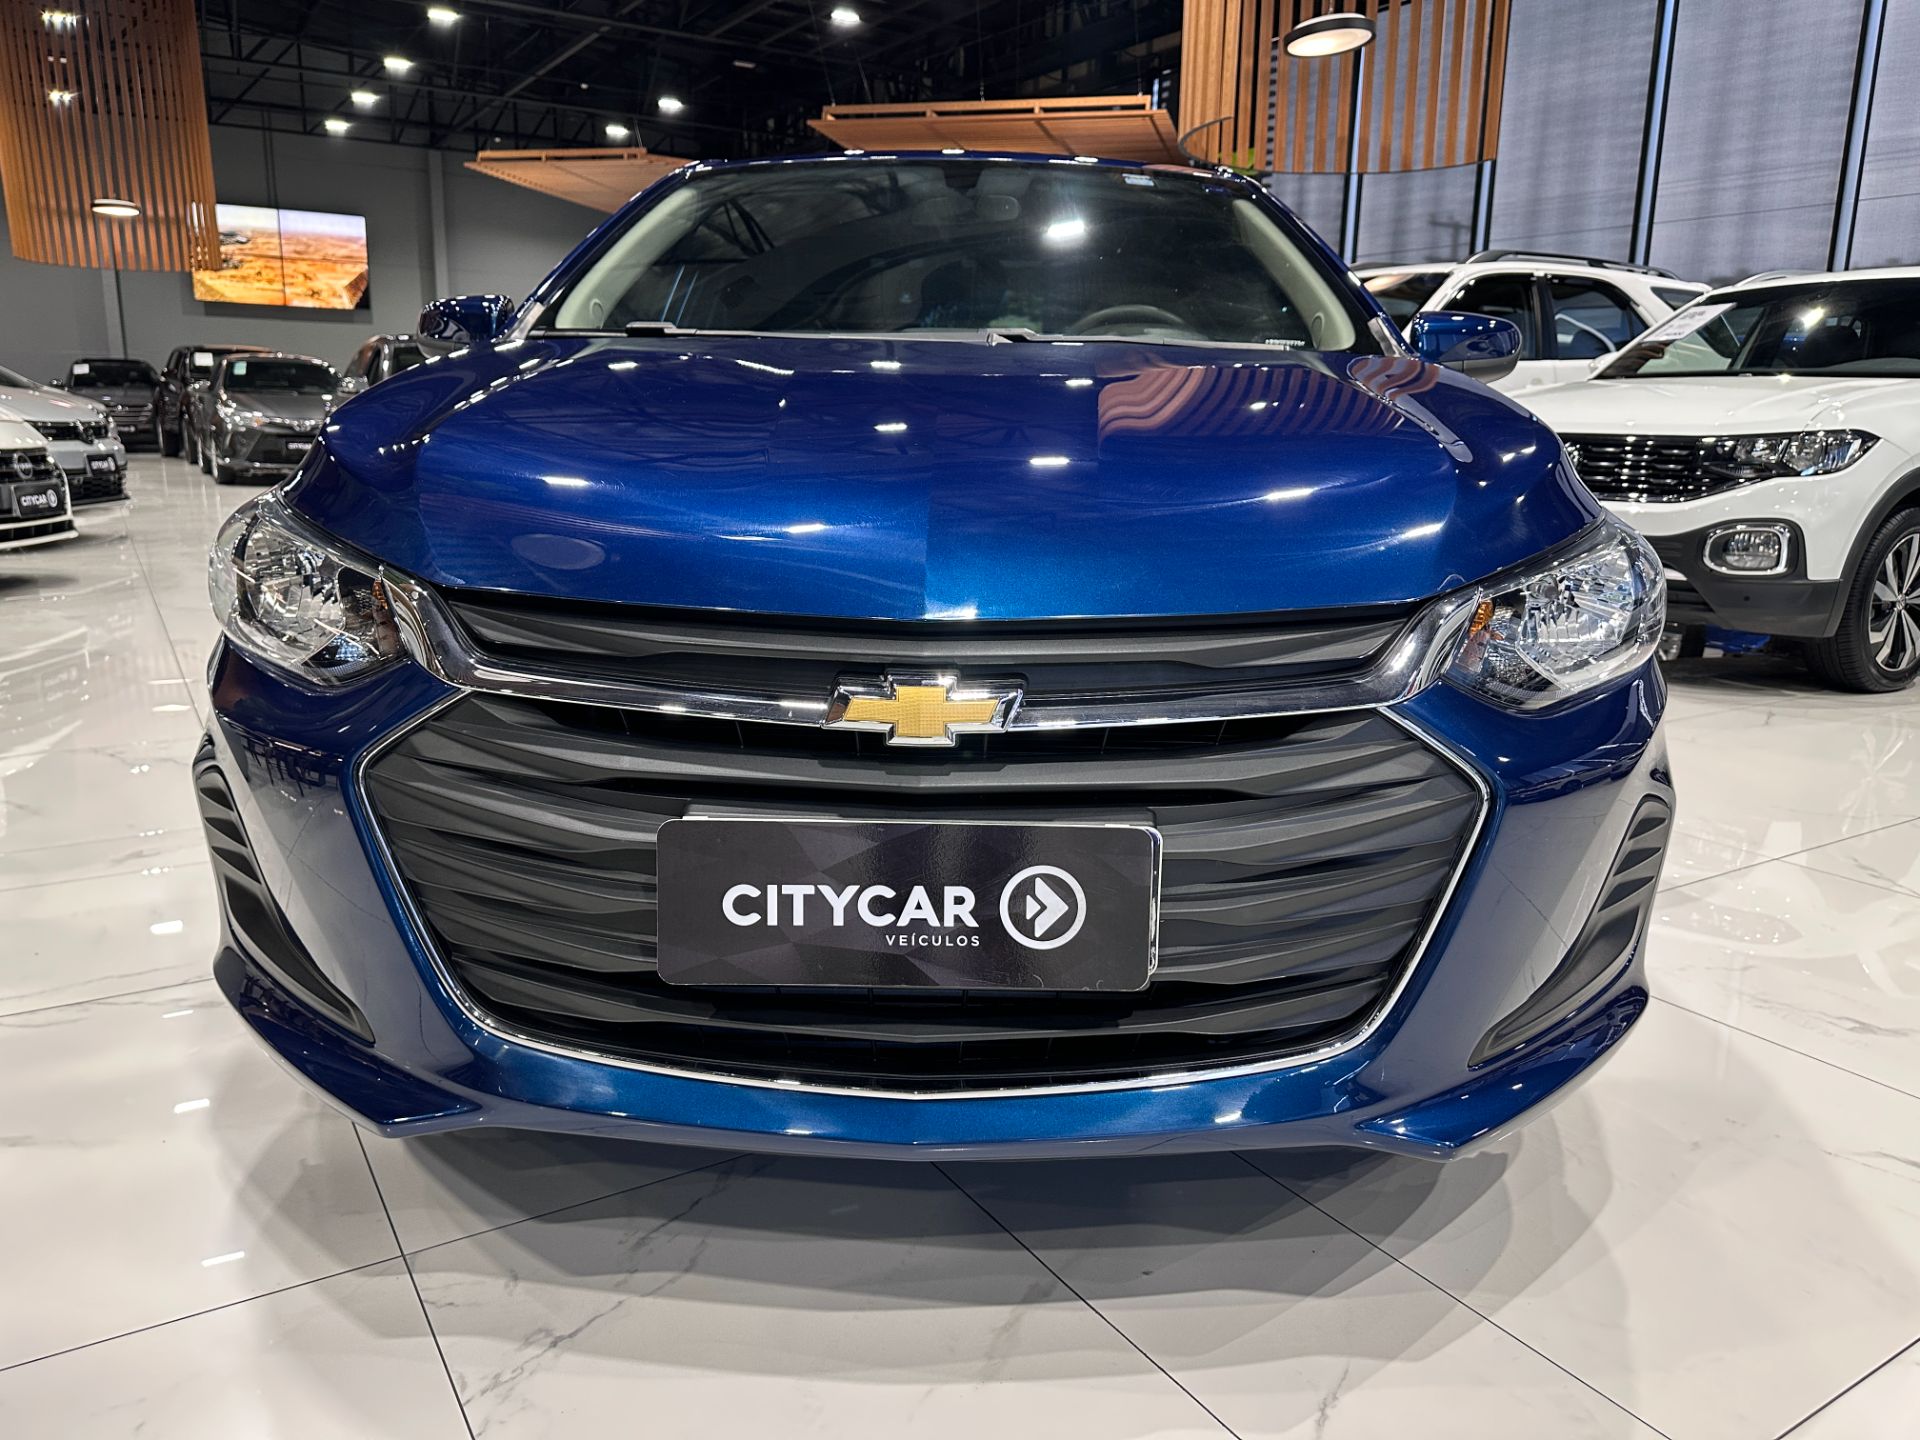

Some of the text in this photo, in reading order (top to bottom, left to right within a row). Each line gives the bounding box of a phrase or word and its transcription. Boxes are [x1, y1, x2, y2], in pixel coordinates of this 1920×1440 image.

[21, 494, 48, 507] CITYCAR
[722, 884, 979, 927] CITYCAR
[886, 932, 980, 946] VEÍCULOS
